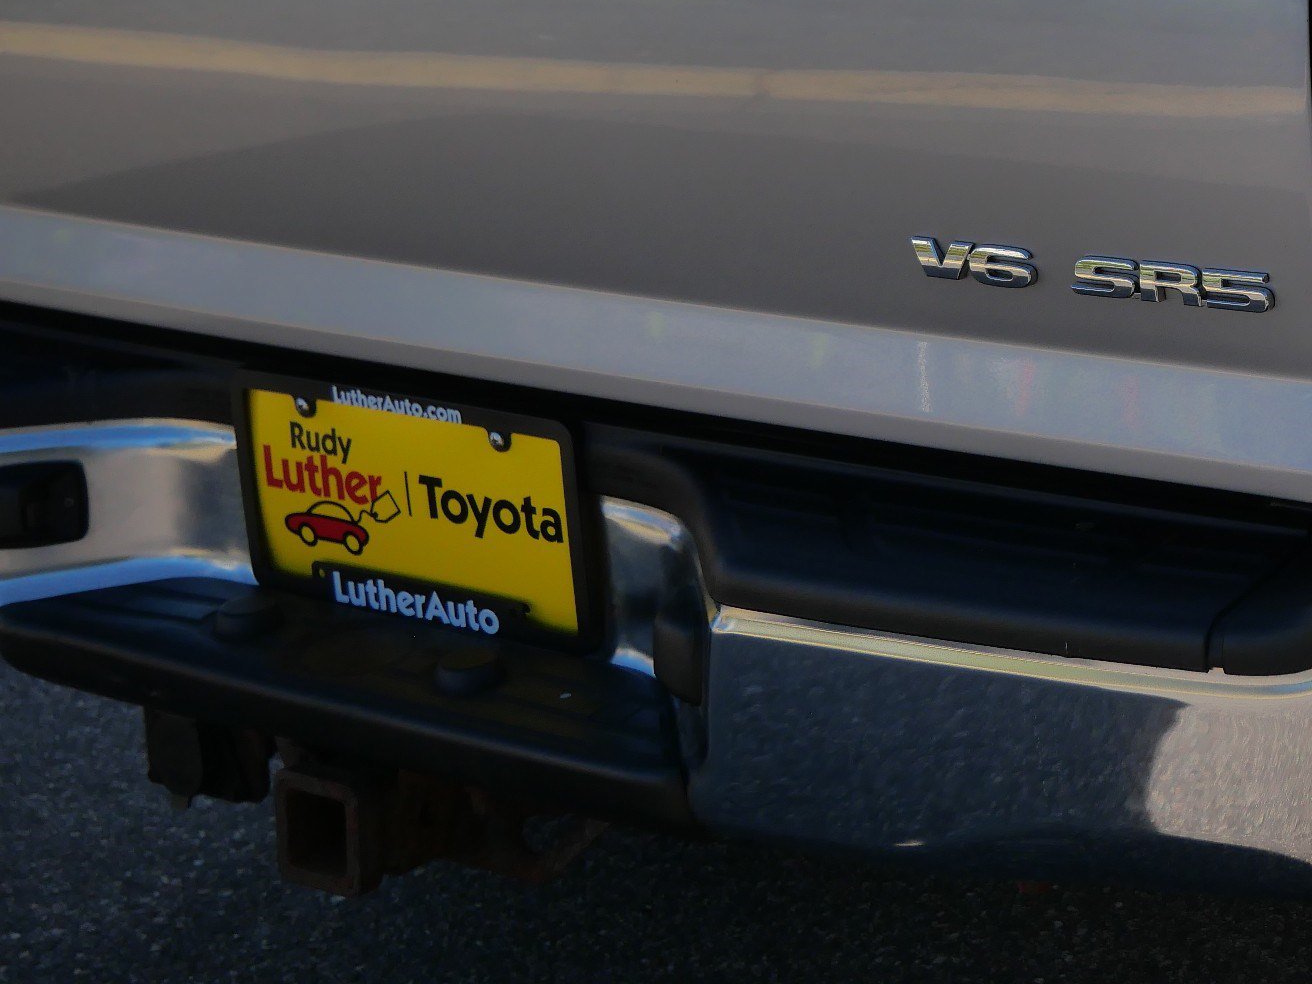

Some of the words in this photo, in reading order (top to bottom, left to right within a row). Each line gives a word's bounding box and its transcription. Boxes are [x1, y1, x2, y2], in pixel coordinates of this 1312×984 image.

[910, 235, 1039, 289] V6
[1071, 254, 1276, 314] SR5
[330, 384, 463, 425] LutherAuto.com
[289, 421, 352, 464] Rudy
[262, 444, 383, 506] Luther
[418, 474, 564, 544] Toyota
[332, 571, 501, 635] LutherAuto
